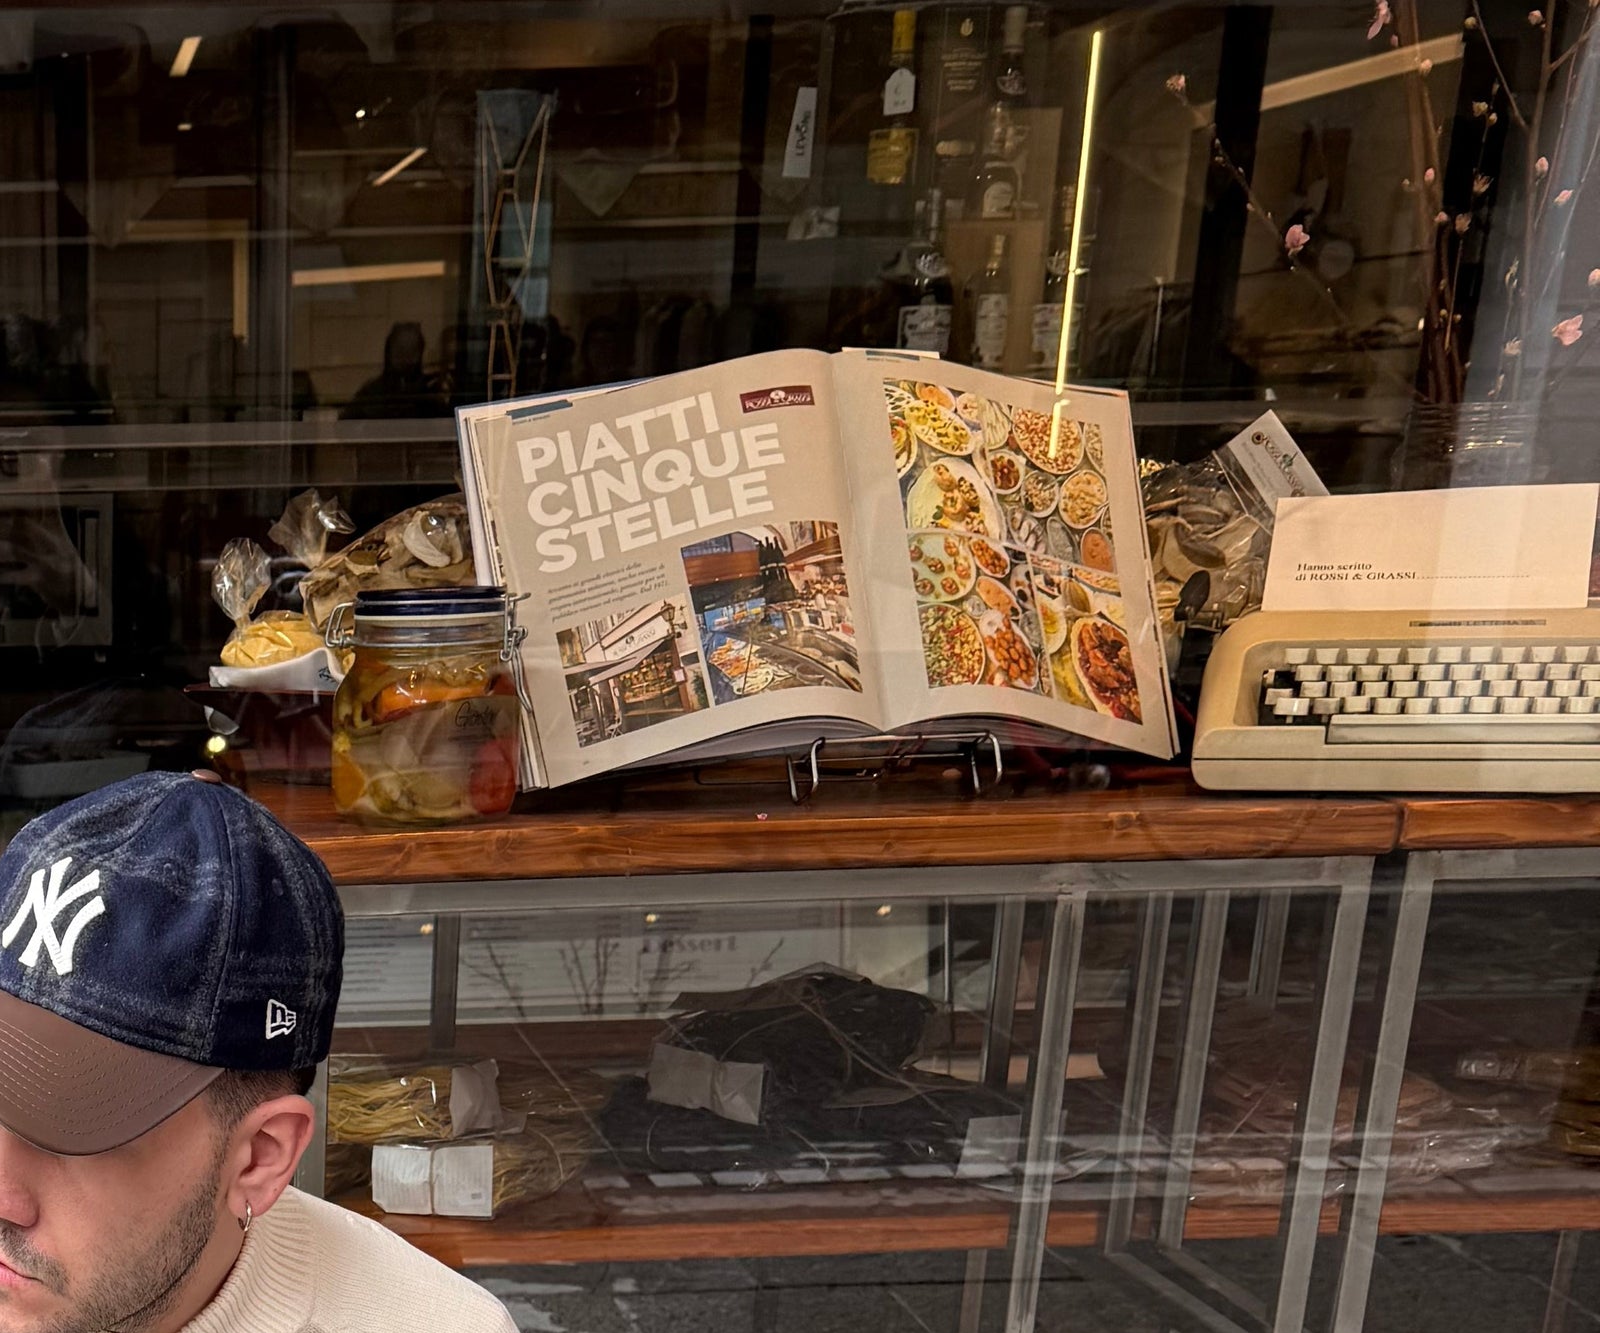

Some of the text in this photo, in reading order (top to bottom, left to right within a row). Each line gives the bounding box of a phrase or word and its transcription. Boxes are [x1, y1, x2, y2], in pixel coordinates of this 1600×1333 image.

[516, 391, 720, 484] PIATTI
[527, 422, 785, 527] CINQUE
[535, 470, 774, 573] STELLE
[1297, 562, 1373, 572] Hanno scritto
[1295, 573, 1307, 582] di
[1310, 573, 1349, 582] ROSSI
[2, 856, 105, 975] NY
